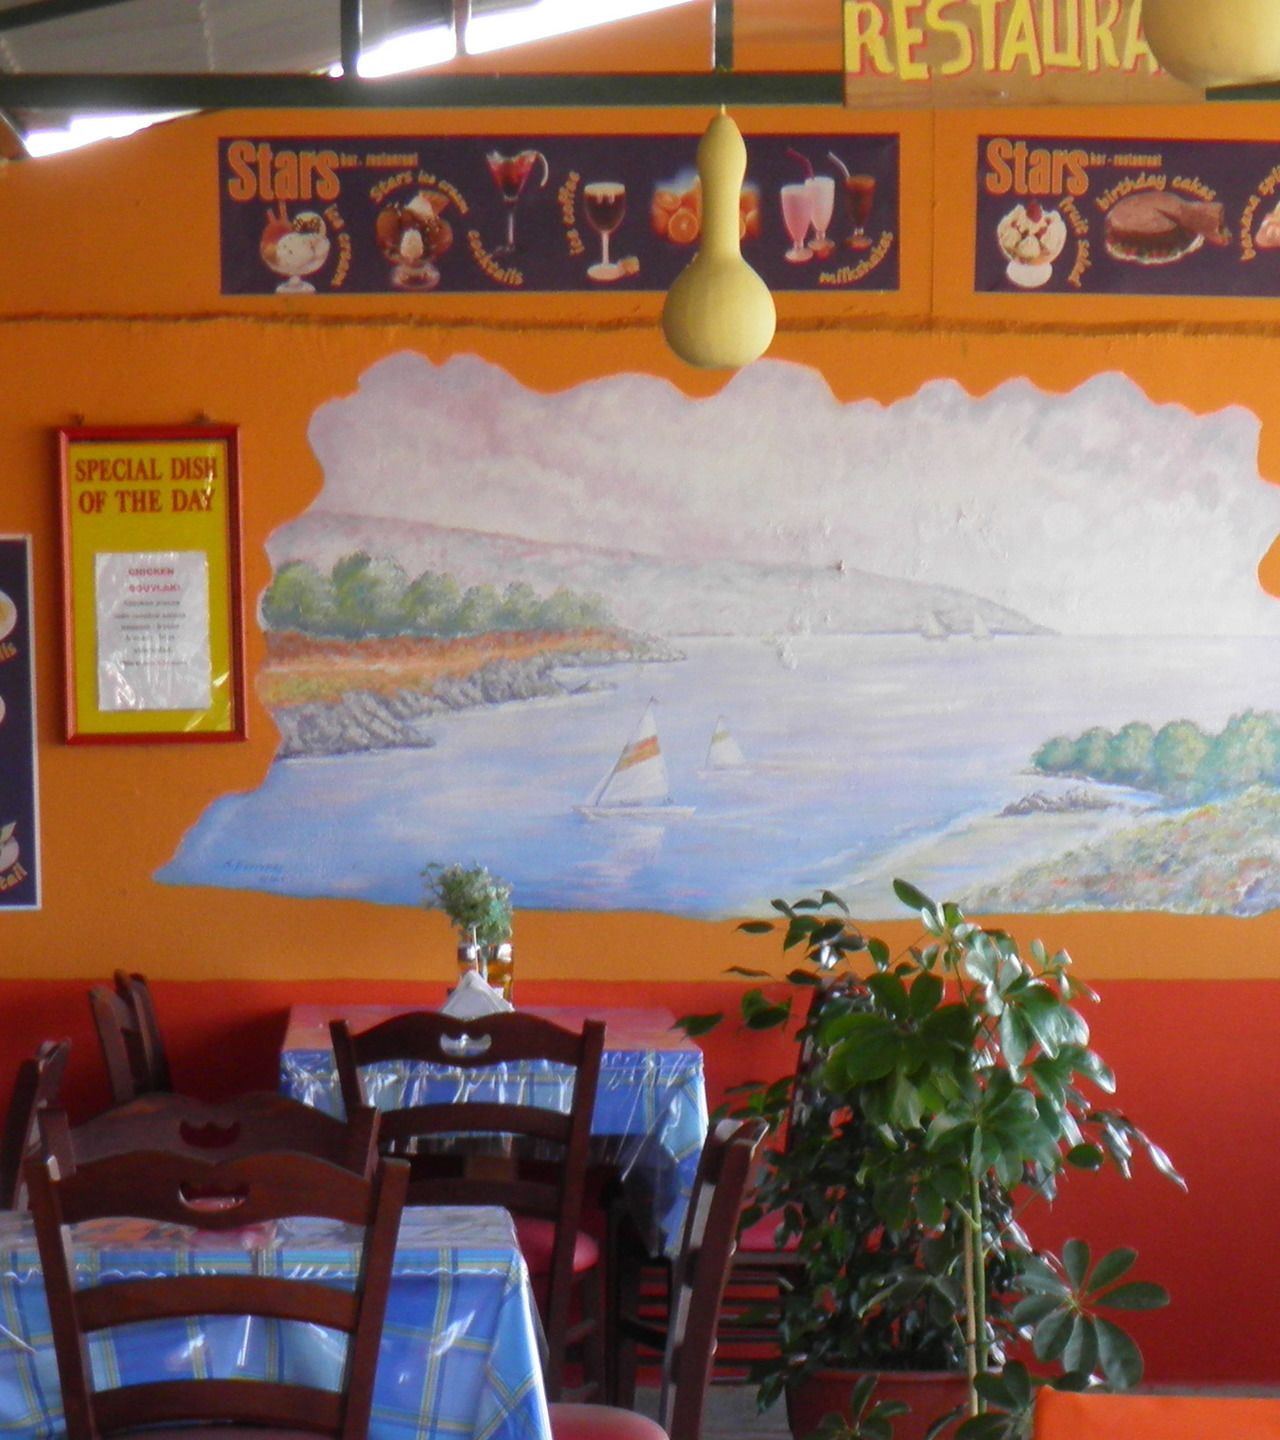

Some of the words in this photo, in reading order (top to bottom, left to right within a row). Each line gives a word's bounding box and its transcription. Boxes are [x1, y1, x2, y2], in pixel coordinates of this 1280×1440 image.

[845, 0, 1170, 80] RESTAURA
[227, 140, 340, 201] Stars
[986, 138, 1089, 195] Stars
[1096, 171, 1167, 211] birthday
[1171, 175, 1218, 202] cakes
[1058, 196, 1089, 235] fruit
[75, 457, 163, 482] SPECIAL
[171, 455, 218, 480] DISH
[78, 489, 108, 514] OF
[115, 489, 163, 513] THE
[172, 488, 216, 512] DAY
[128, 567, 175, 577] CHICKEN
